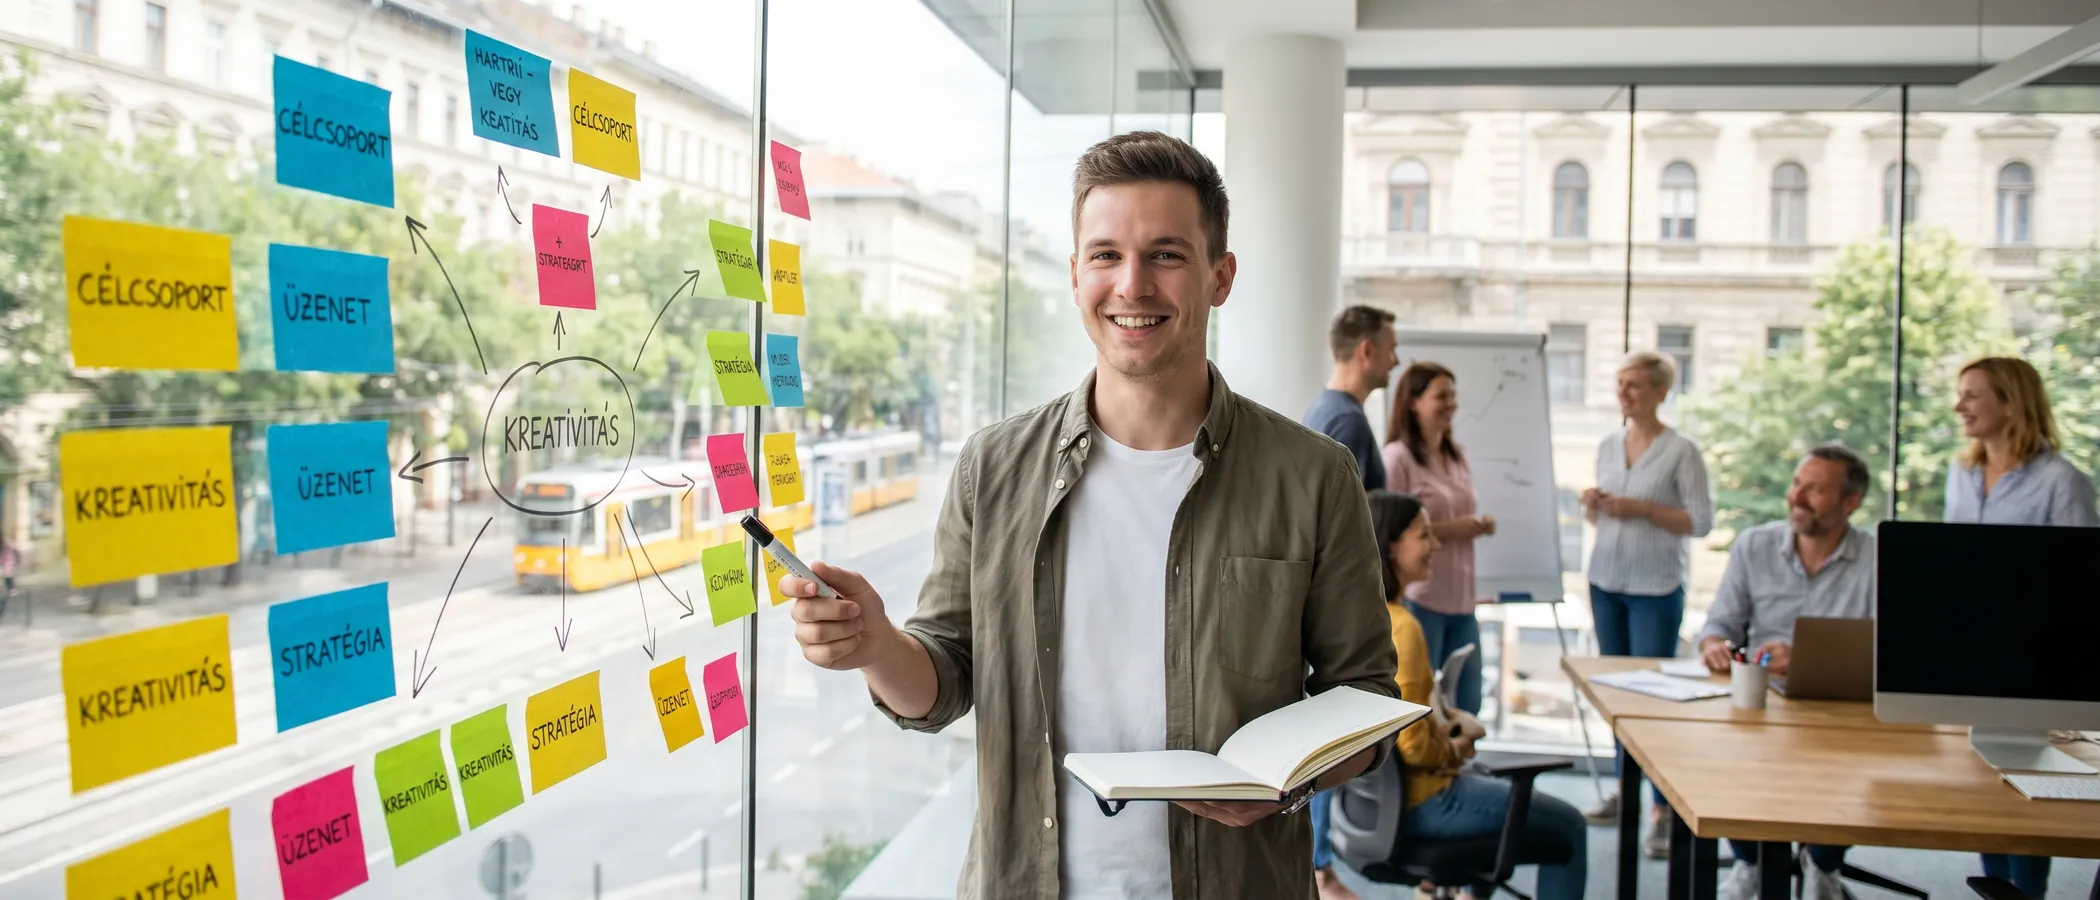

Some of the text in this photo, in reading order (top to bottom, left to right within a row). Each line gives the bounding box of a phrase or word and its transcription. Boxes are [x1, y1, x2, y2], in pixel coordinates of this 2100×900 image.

[490, 81, 521, 105] VEGY
[279, 103, 389, 157] CÉLCSOPORT
[574, 102, 632, 142] CÉLCSOPORT
[77, 261, 226, 310] CÉLCSOPORT
[284, 282, 370, 324] ÜZENET
[299, 465, 375, 500] ÜZENET
[281, 624, 384, 676] STRATÉGIA
[79, 657, 225, 726] KREATIVITÁS
[658, 689, 690, 716] ÜZENET
[532, 705, 596, 750] STRATÉGIA
[459, 743, 513, 782] KREATIVITÁS
[384, 773, 447, 815] KREATIVITÁS
[282, 814, 350, 865] ÜZENET
